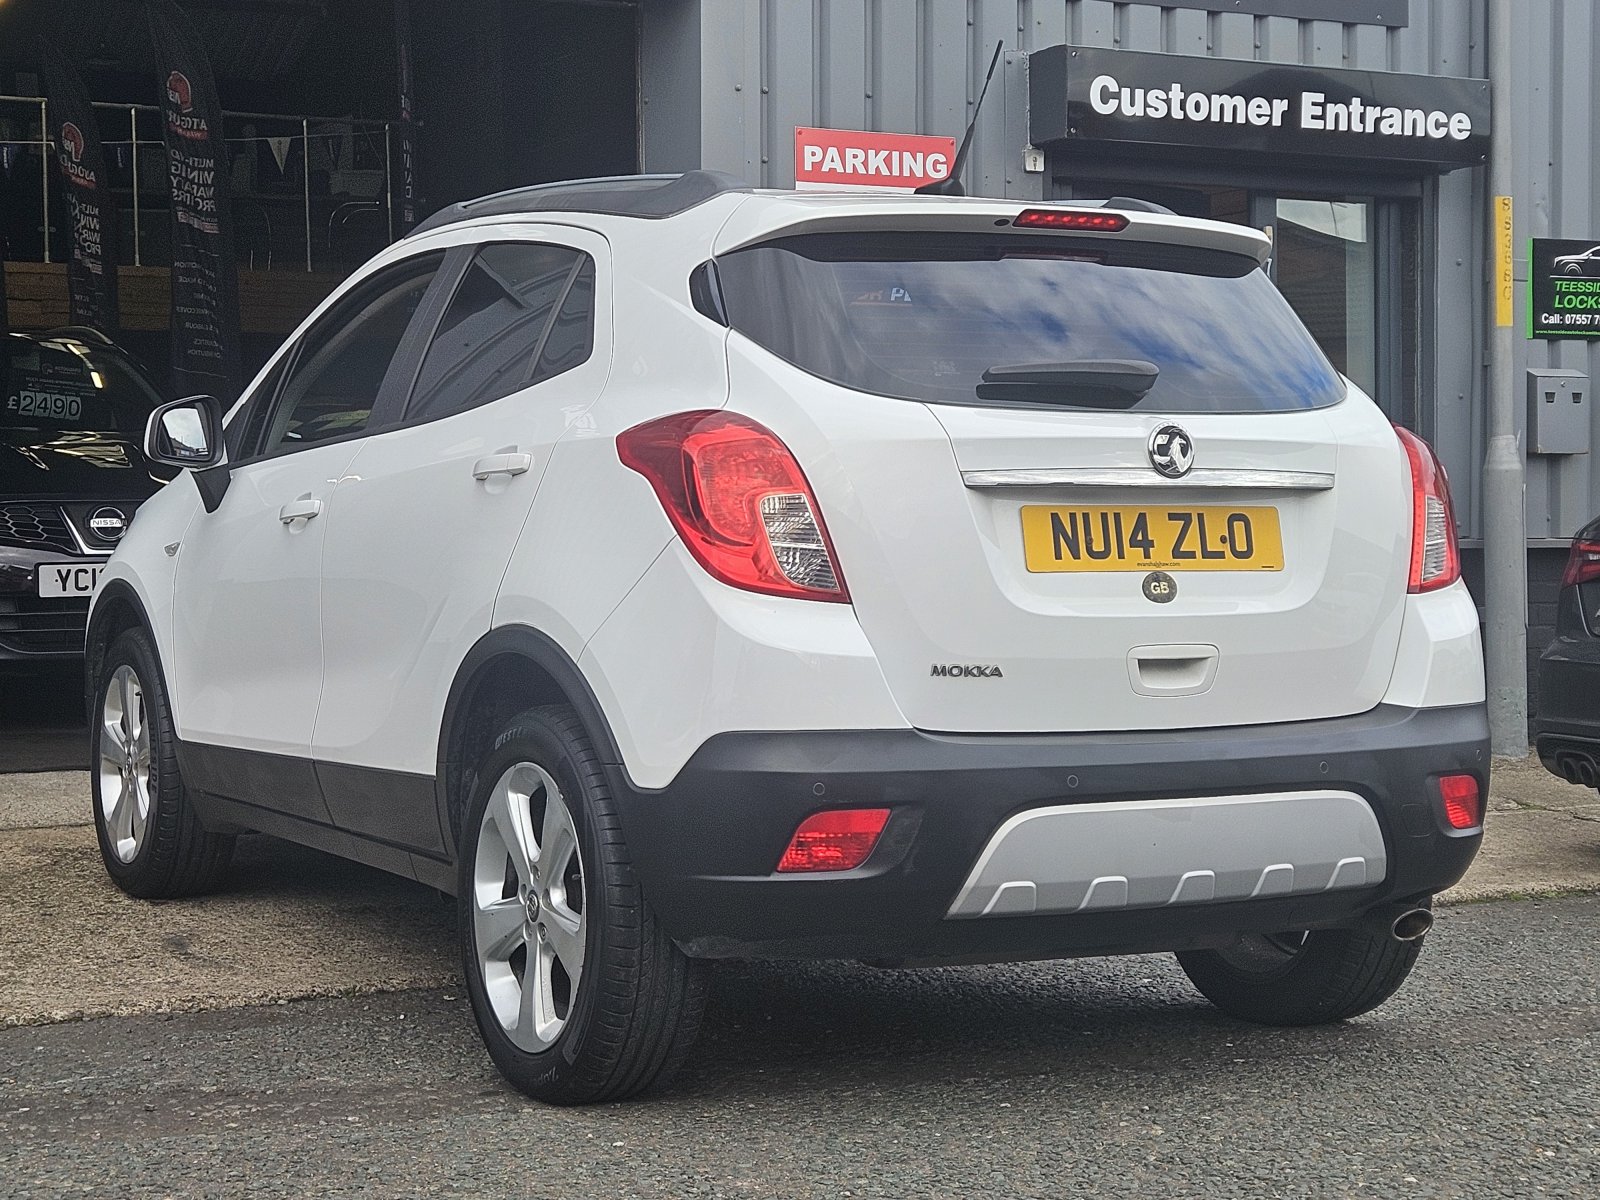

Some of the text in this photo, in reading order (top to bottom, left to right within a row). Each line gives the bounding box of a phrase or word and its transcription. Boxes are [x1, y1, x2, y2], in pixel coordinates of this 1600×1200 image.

[1089, 74, 1472, 140] Customer Entrance
[804, 145, 948, 179] PARKING
[1554, 295, 1600, 308] LOCK
[1541, 313, 1563, 324] Call:
[1565, 314, 1592, 324] 07557
[7, 395, 80, 417] £2490
[92, 519, 127, 527] NISSAN
[1051, 512, 1254, 560] NU14 ZLO
[57, 568, 104, 591] YC1
[1150, 581, 1170, 594] GB
[930, 664, 1003, 678] MOKKA
